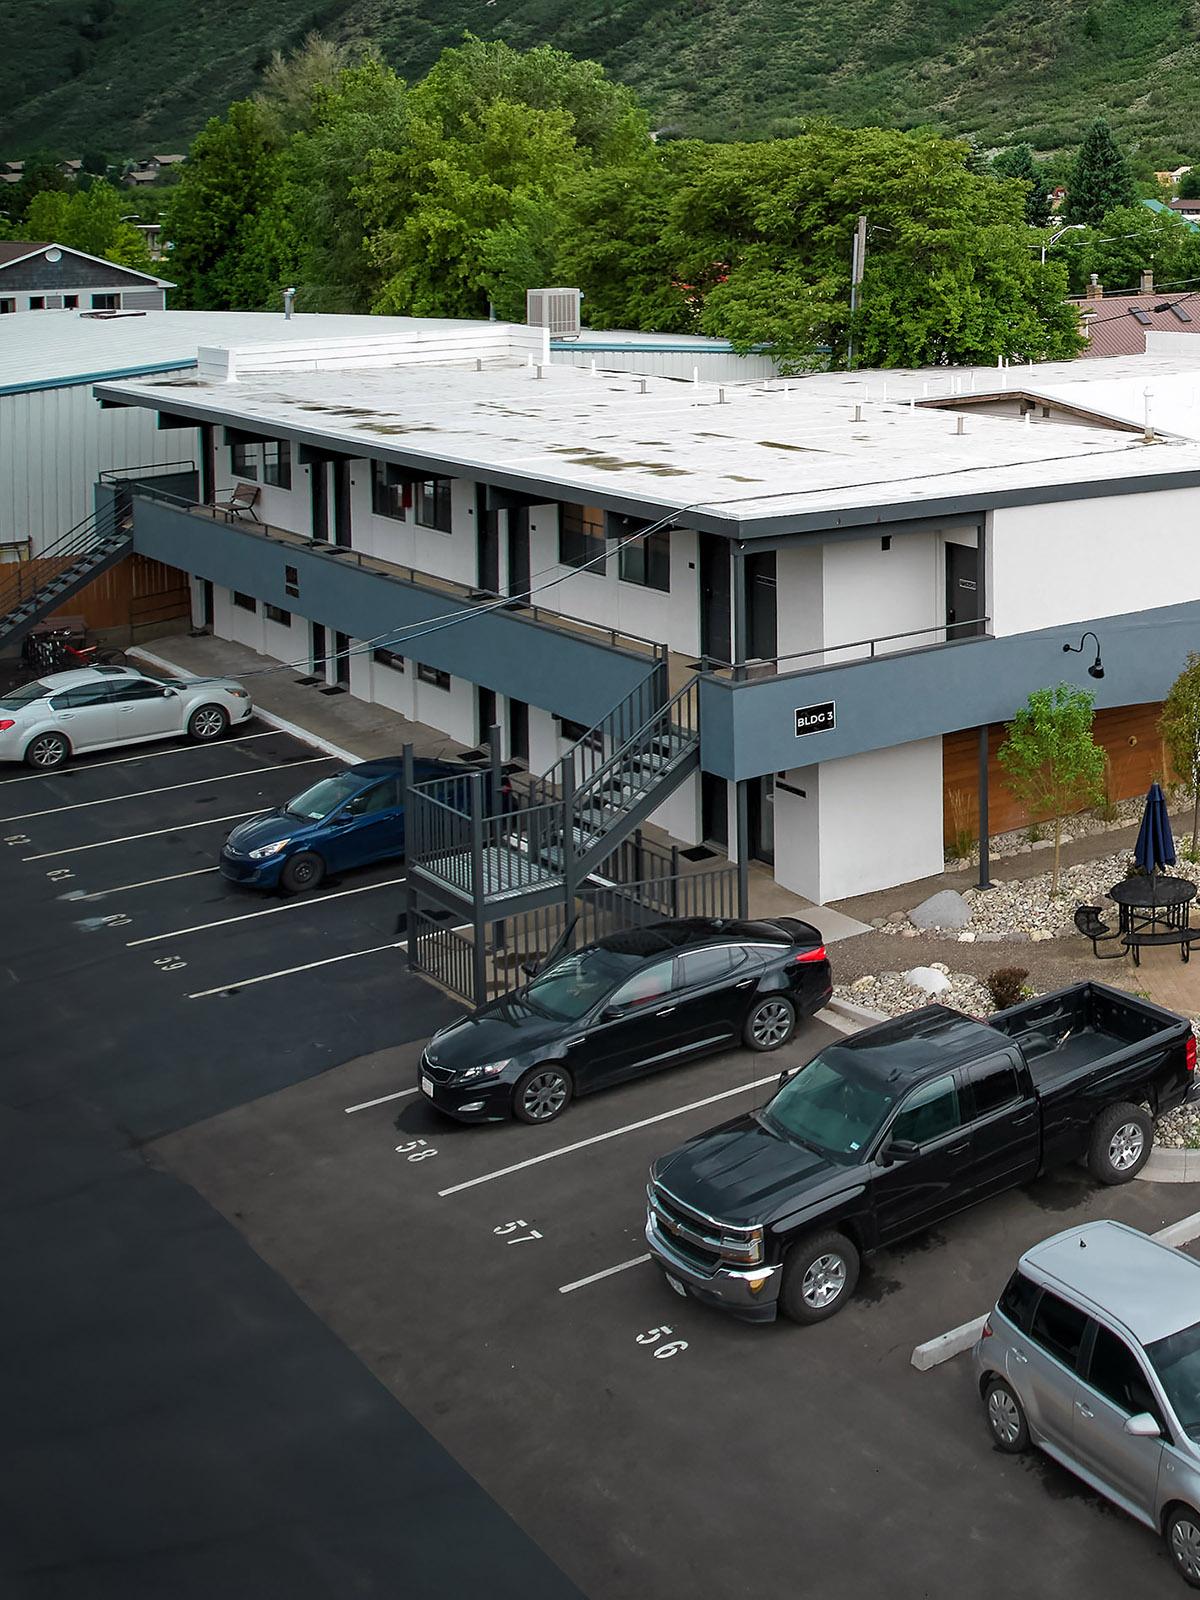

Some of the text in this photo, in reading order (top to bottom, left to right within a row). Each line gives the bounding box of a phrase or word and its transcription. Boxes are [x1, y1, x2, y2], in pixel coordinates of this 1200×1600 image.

[797, 711, 834, 728] BLDG 3
[46, 869, 76, 882] 61
[102, 913, 133, 927] 60
[153, 955, 188, 971] 59
[394, 1139, 438, 1162] 58
[493, 1219, 544, 1245] 57
[635, 1325, 689, 1359] 56
